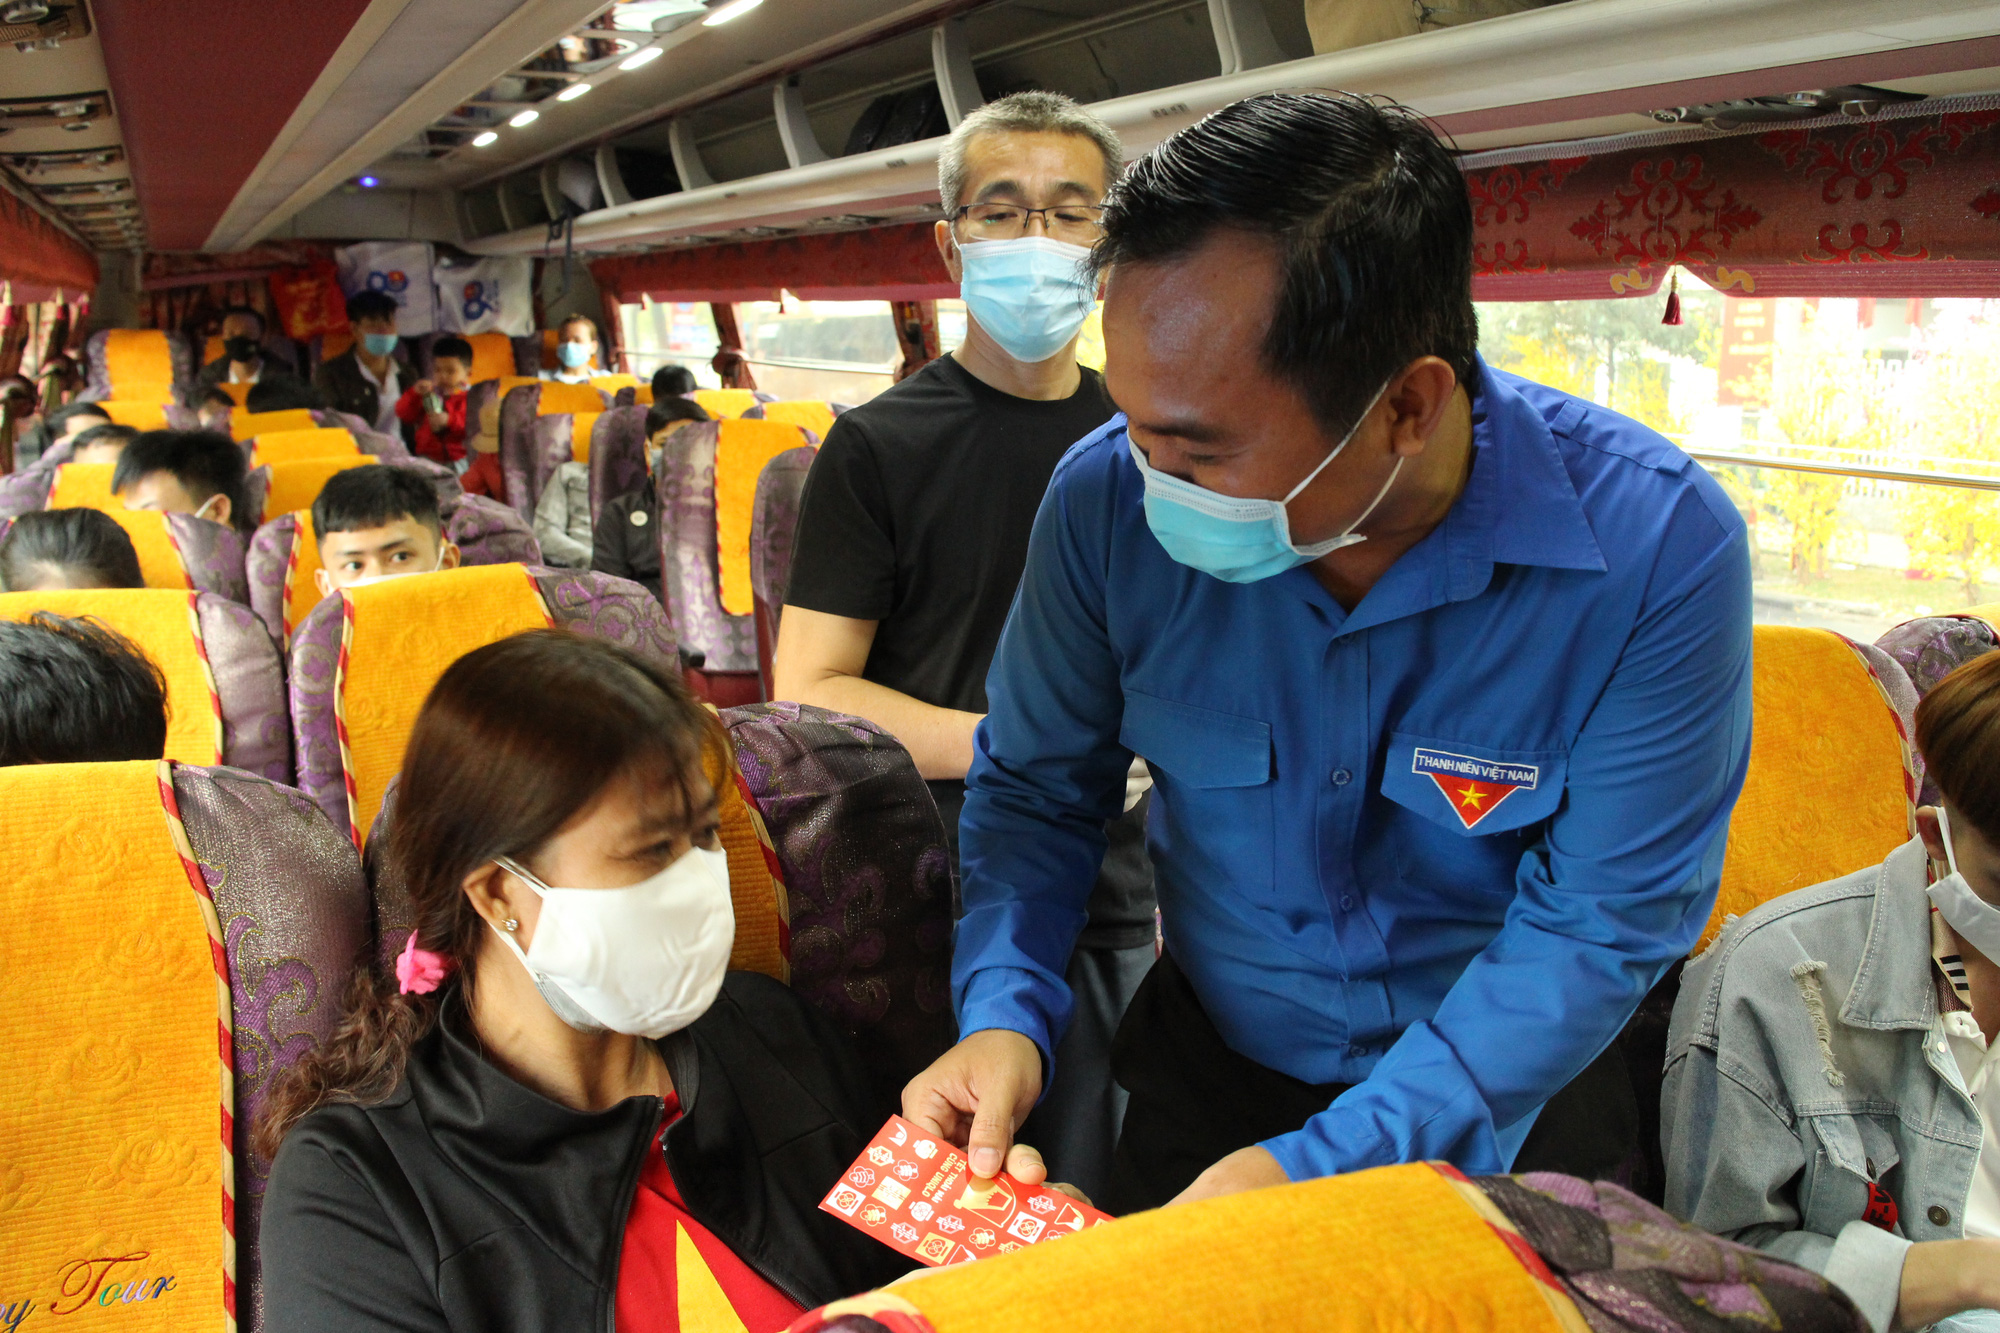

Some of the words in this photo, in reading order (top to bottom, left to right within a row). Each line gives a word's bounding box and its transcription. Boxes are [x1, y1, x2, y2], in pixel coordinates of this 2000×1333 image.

[1418, 755, 1454, 770] THANH
[1455, 761, 1480, 776] NIÊN
[1480, 766, 1508, 780] VIỆT
[1507, 770, 1534, 782] NAM
[922, 1171, 945, 1197] UNIQLO
[50, 1250, 178, 1315] Tour
